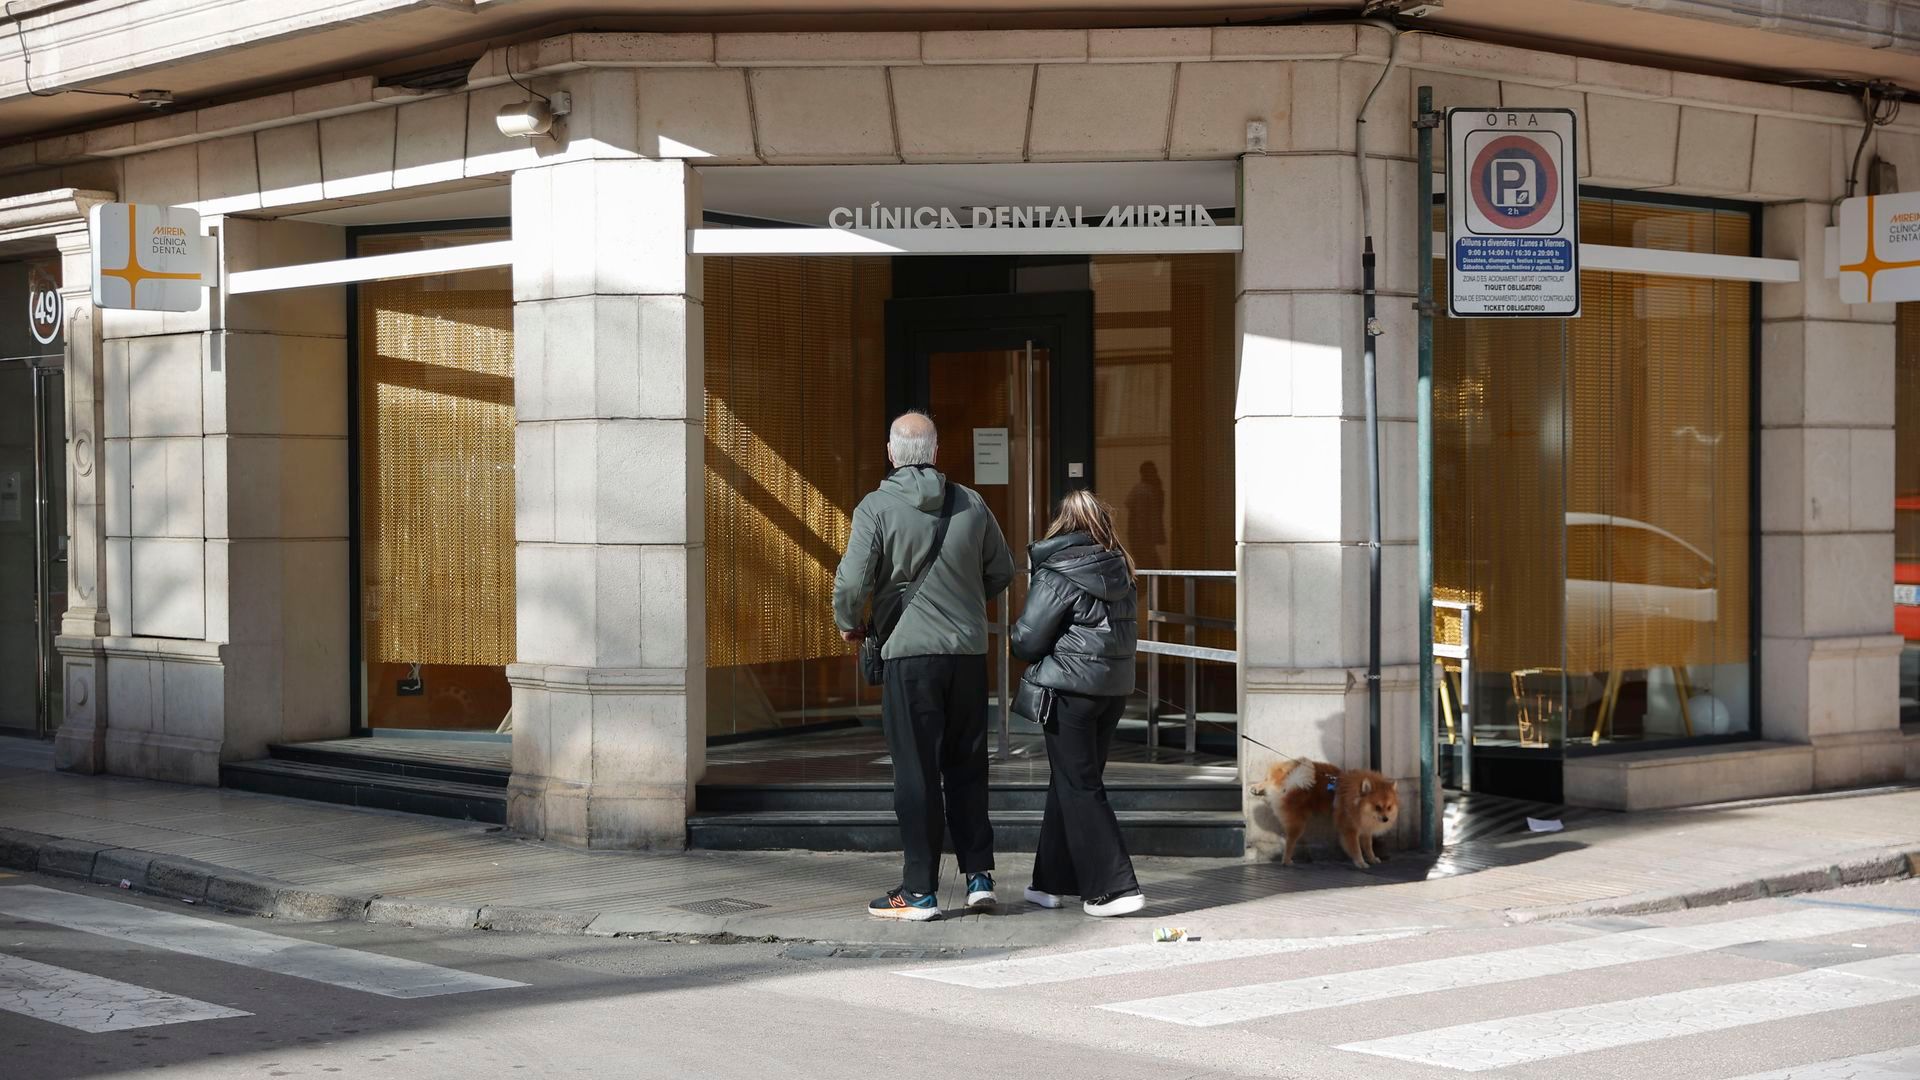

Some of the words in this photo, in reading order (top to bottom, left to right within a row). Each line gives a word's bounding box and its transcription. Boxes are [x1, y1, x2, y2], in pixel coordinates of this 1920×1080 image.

[1496, 162, 1526, 205] P
[828, 202, 962, 230] CLÍNICA
[972, 206, 1089, 230] DENTAL
[1100, 204, 1217, 229] MIREIA
[152, 226, 186, 237] MIREIA
[152, 236, 187, 247] CLÍNICA
[1461, 238, 1481, 247] Dilluns
[1487, 239, 1516, 247] divendres
[1520, 239, 1538, 248] Lunes
[1544, 239, 1565, 248] Viernes
[152, 246, 187, 256] DENTAL
[1515, 249, 1532, 257] 16:30
[35, 290, 56, 325] 49
[1506, 304, 1546, 312] OBLIGATORIO
